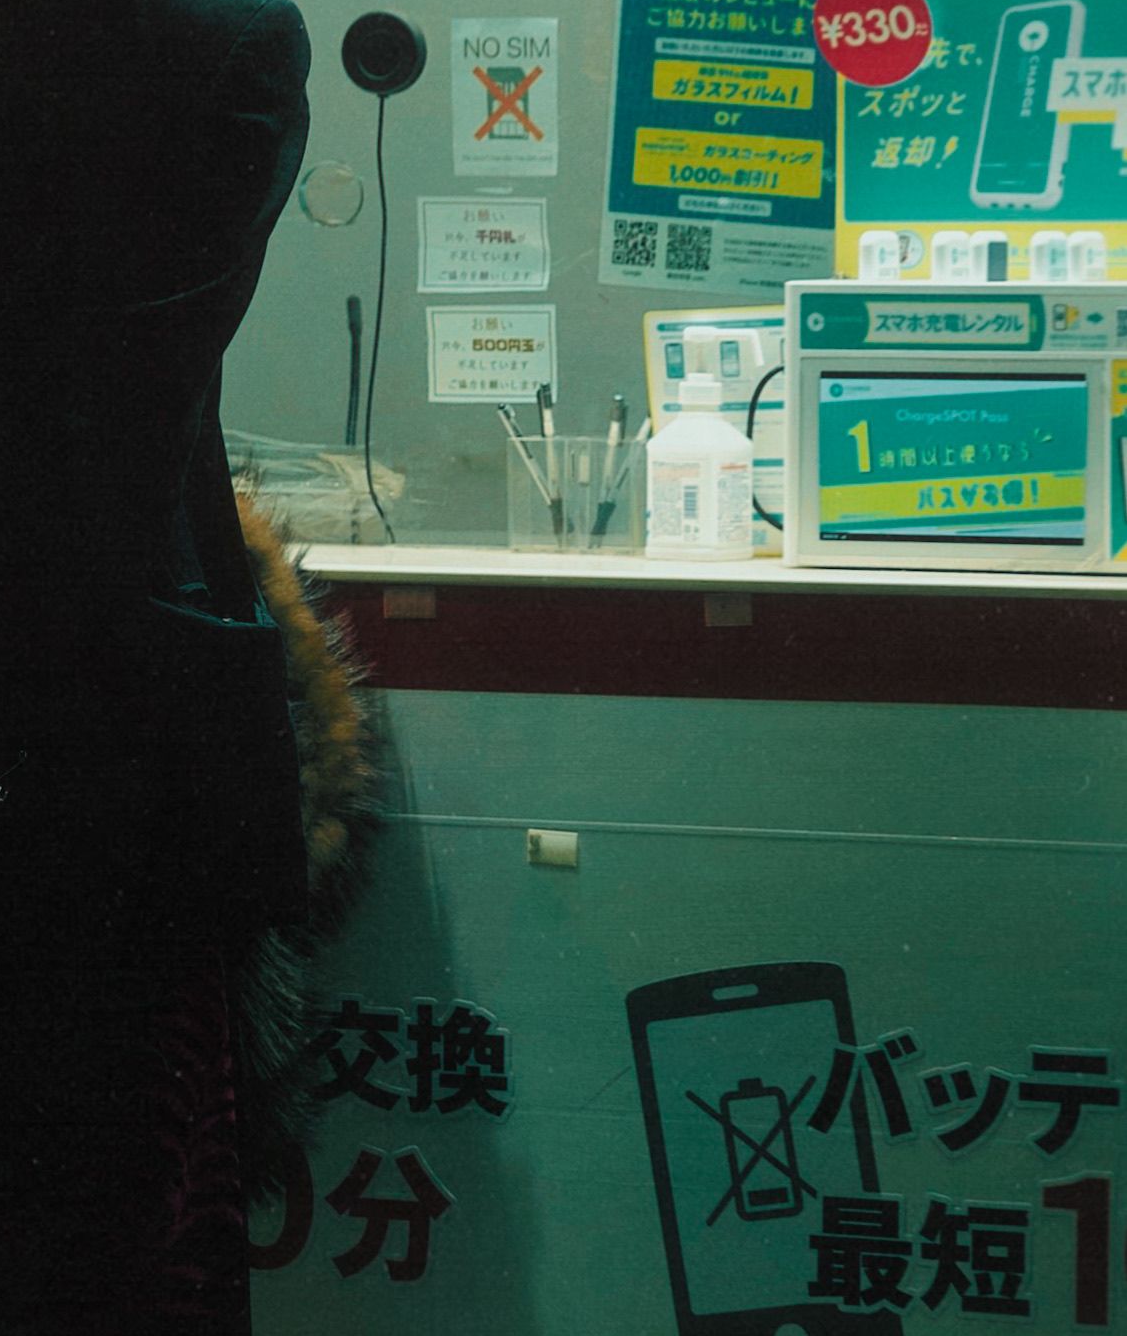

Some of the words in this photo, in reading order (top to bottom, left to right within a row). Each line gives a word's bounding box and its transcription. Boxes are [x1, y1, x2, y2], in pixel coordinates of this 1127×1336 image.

[647, 8, 815, 36] ご協力お願いしま
[817, 4, 916, 49] ¥330
[464, 36, 501, 59] NO
[506, 36, 551, 59] SIM
[858, 84, 969, 118] スポッと
[714, 111, 742, 126] or
[874, 312, 1024, 335] スマホ充電レンタル
[807, 1027, 1122, 1158] バッテ
